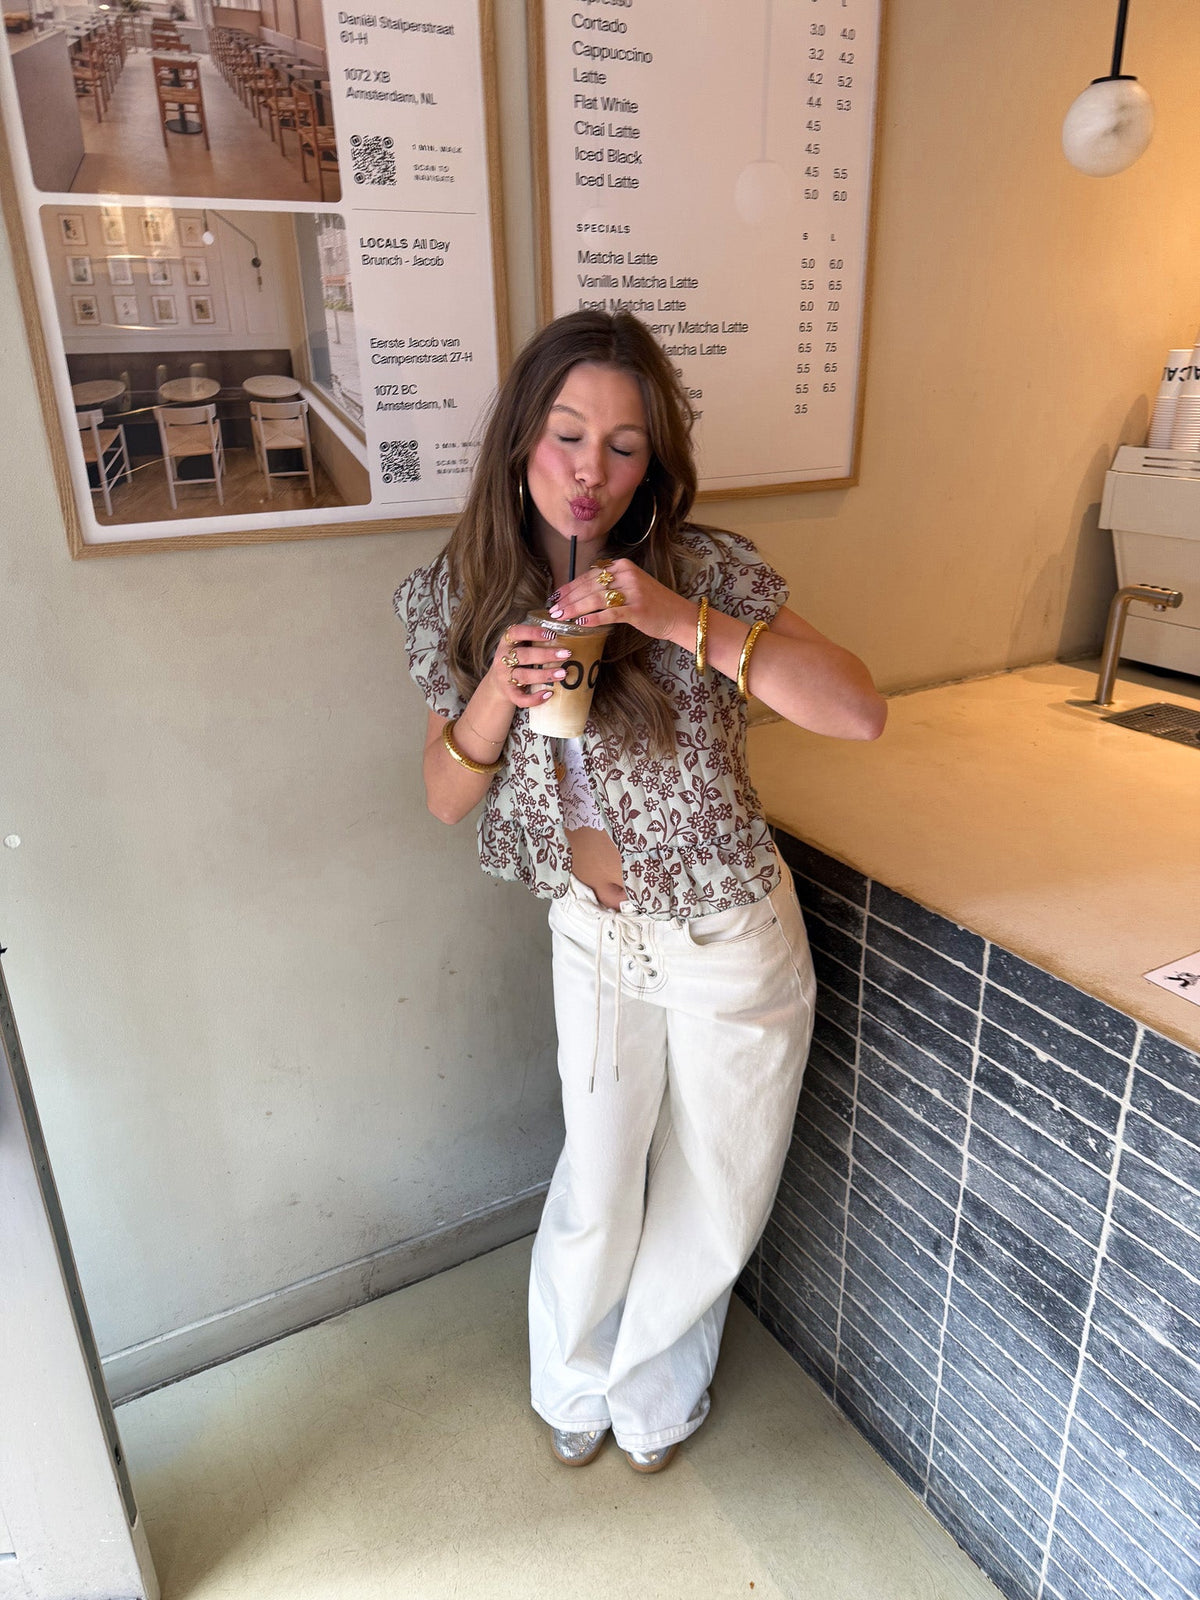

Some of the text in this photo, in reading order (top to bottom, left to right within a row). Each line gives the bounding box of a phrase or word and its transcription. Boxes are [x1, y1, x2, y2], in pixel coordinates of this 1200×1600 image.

[571, 13, 628, 34] Cortado
[340, 30, 368, 45] 61-H
[572, 40, 653, 63] Cappuccino
[344, 68, 391, 83] 1072 XB
[573, 67, 607, 85] Latte
[346, 86, 438, 105] Amsterdam, NL
[573, 94, 639, 114] Flat White
[574, 120, 640, 139] Chai Latte
[574, 146, 642, 165] Iced Black
[575, 172, 640, 189] Iced Latte
[576, 223, 631, 234] SPECIALS
[802, 232, 808, 240] S
[359, 237, 450, 253] LOCALS All Day
[361, 254, 402, 267] Brunch
[412, 255, 444, 267] Jacob
[577, 250, 658, 266] Matcha Latte
[577, 274, 699, 289] Vanilla Matcha Latte
[578, 298, 687, 312] Iced Matcha Latte
[677, 321, 719, 334] Matcha
[722, 321, 749, 333] Latte
[370, 337, 460, 348] Eerste Jacob van
[699, 344, 727, 355] Latte
[371, 352, 473, 366] Campenstraat 27-H
[374, 384, 418, 396] 1072 BC
[376, 398, 458, 412] Amsterdam, NL
